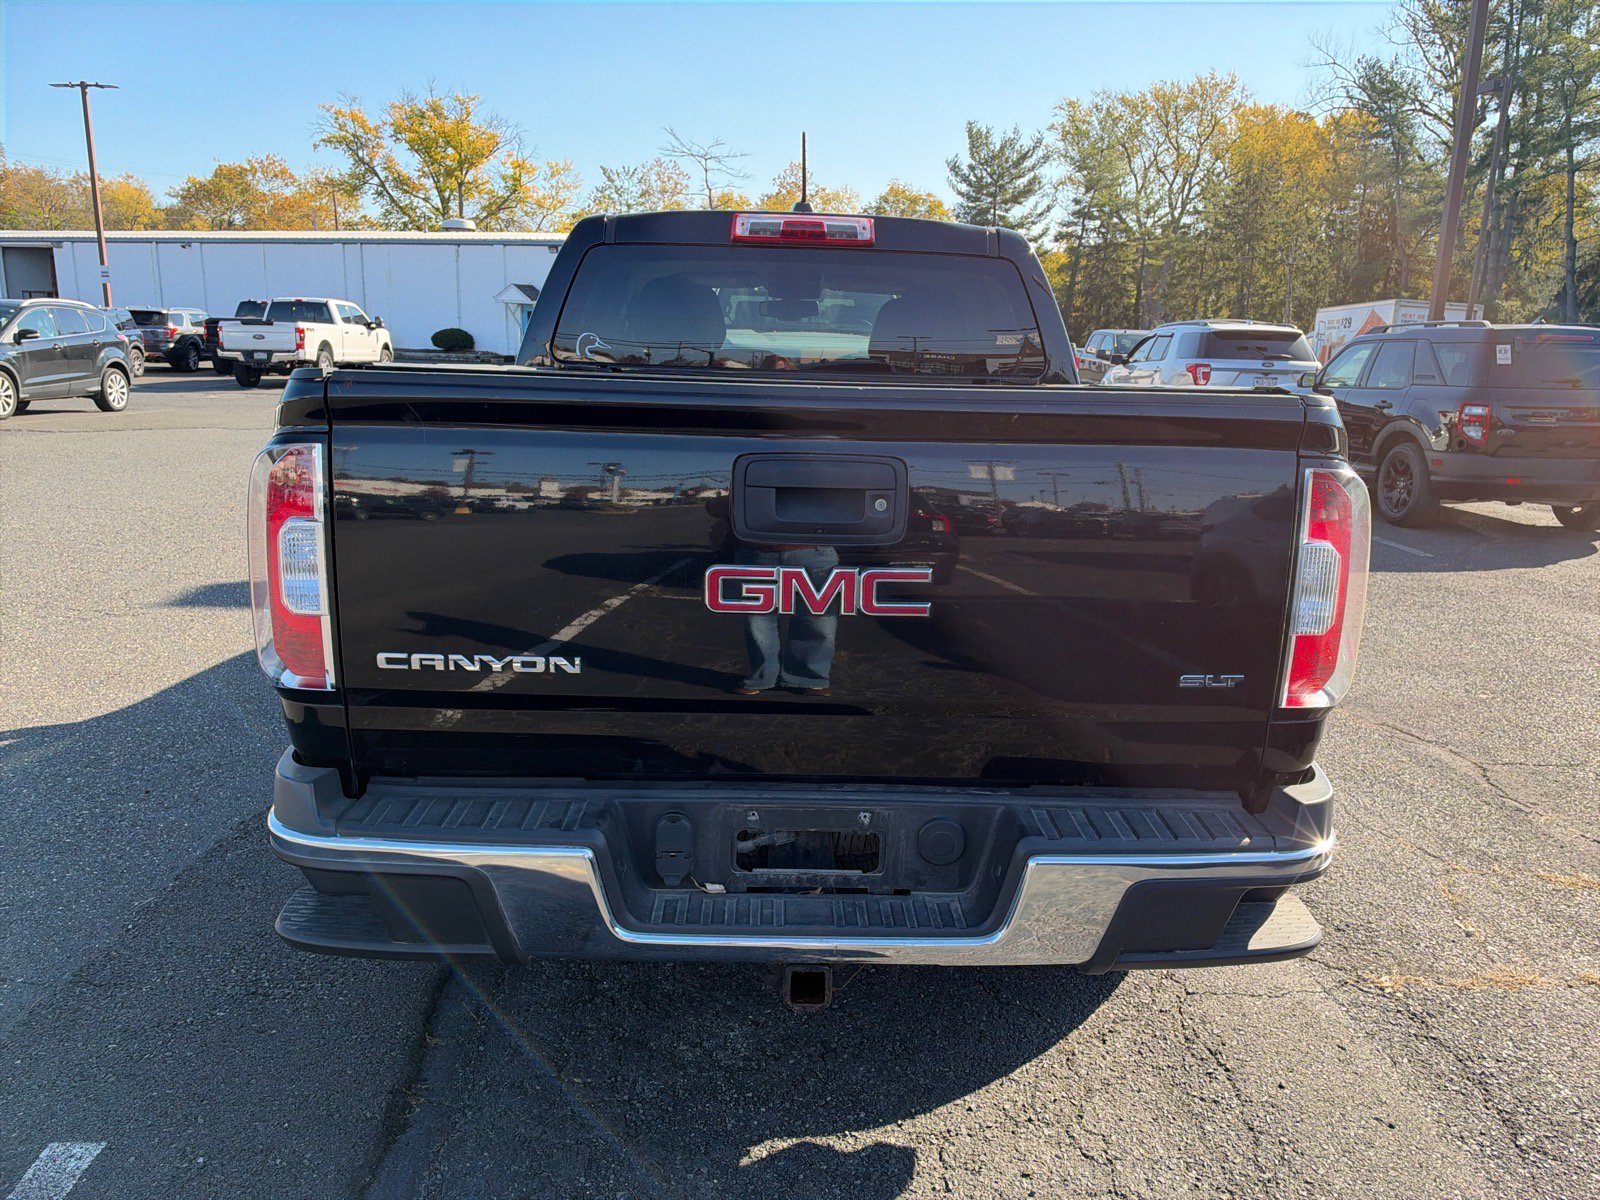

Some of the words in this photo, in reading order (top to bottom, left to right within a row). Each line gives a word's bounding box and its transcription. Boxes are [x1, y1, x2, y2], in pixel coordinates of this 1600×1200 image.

[704, 564, 933, 617] GMC
[376, 652, 582, 674] CANYON
[1179, 674, 1245, 688] SLT
